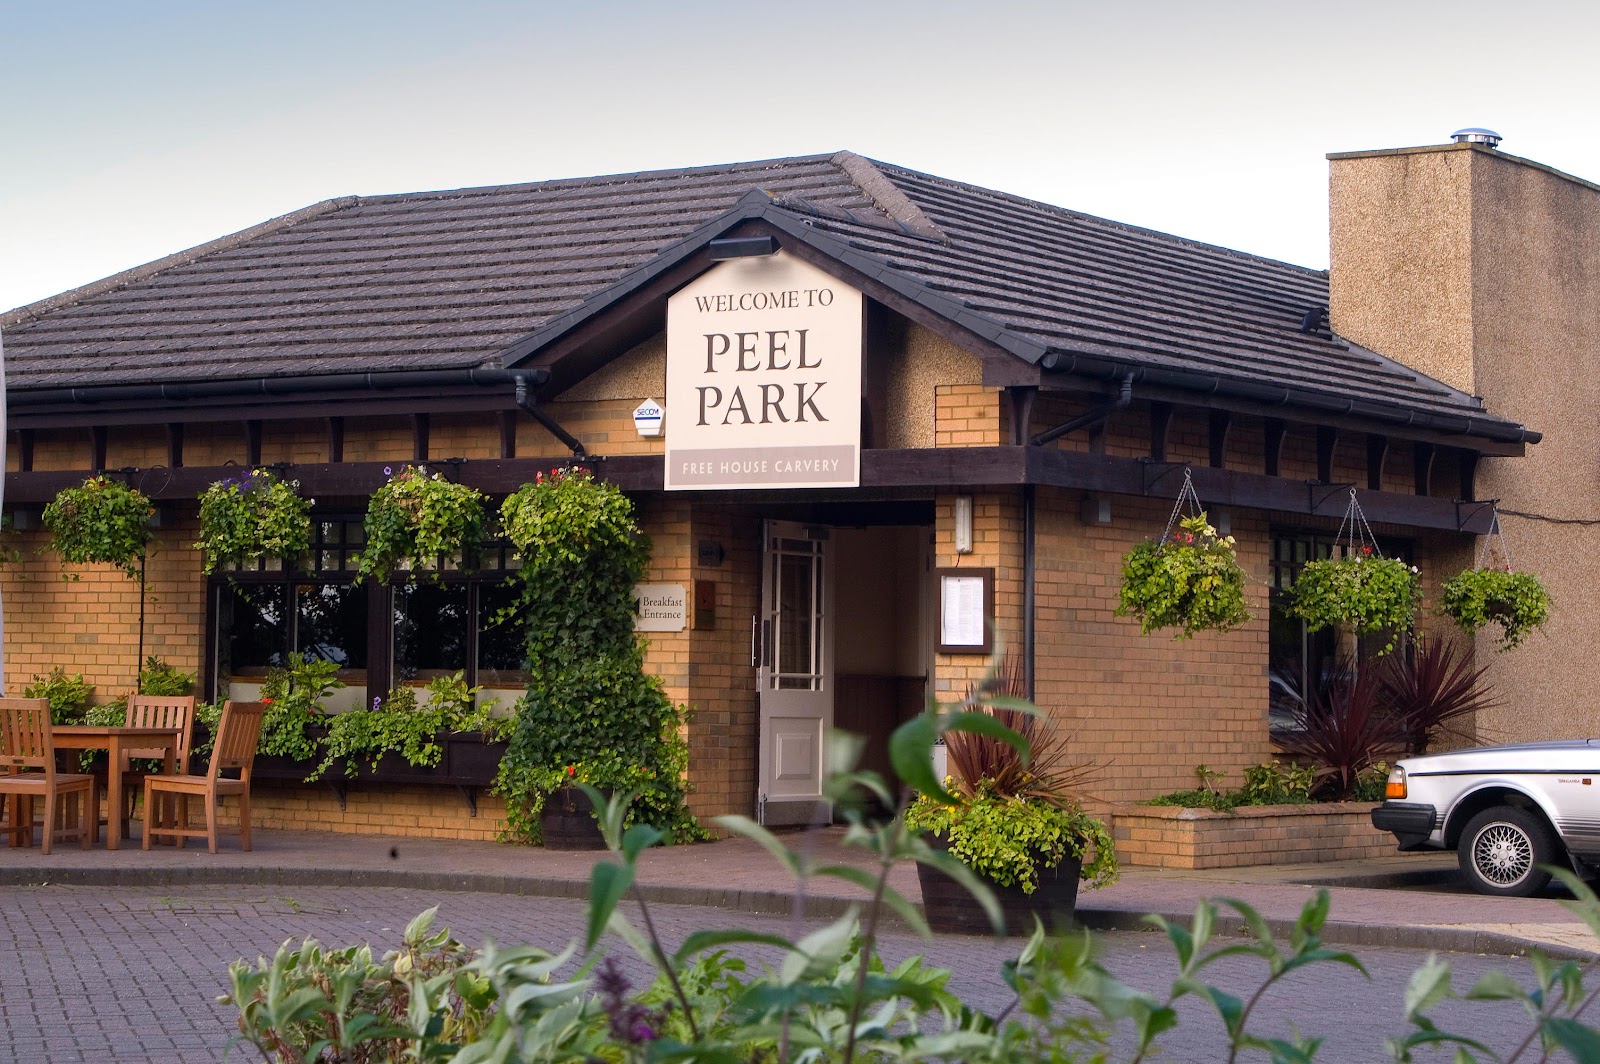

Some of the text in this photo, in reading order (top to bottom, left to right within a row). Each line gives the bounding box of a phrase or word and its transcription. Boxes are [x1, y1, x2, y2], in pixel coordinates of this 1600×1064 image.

[694, 288, 834, 313] WELCOME TO
[703, 329, 822, 373] PEEL
[695, 381, 829, 426] PARK
[636, 408, 660, 416] SECOM
[682, 459, 839, 475] FREE HOUSE CARVERY
[642, 596, 682, 607] Breakfast
[644, 609, 681, 619] Entrance
